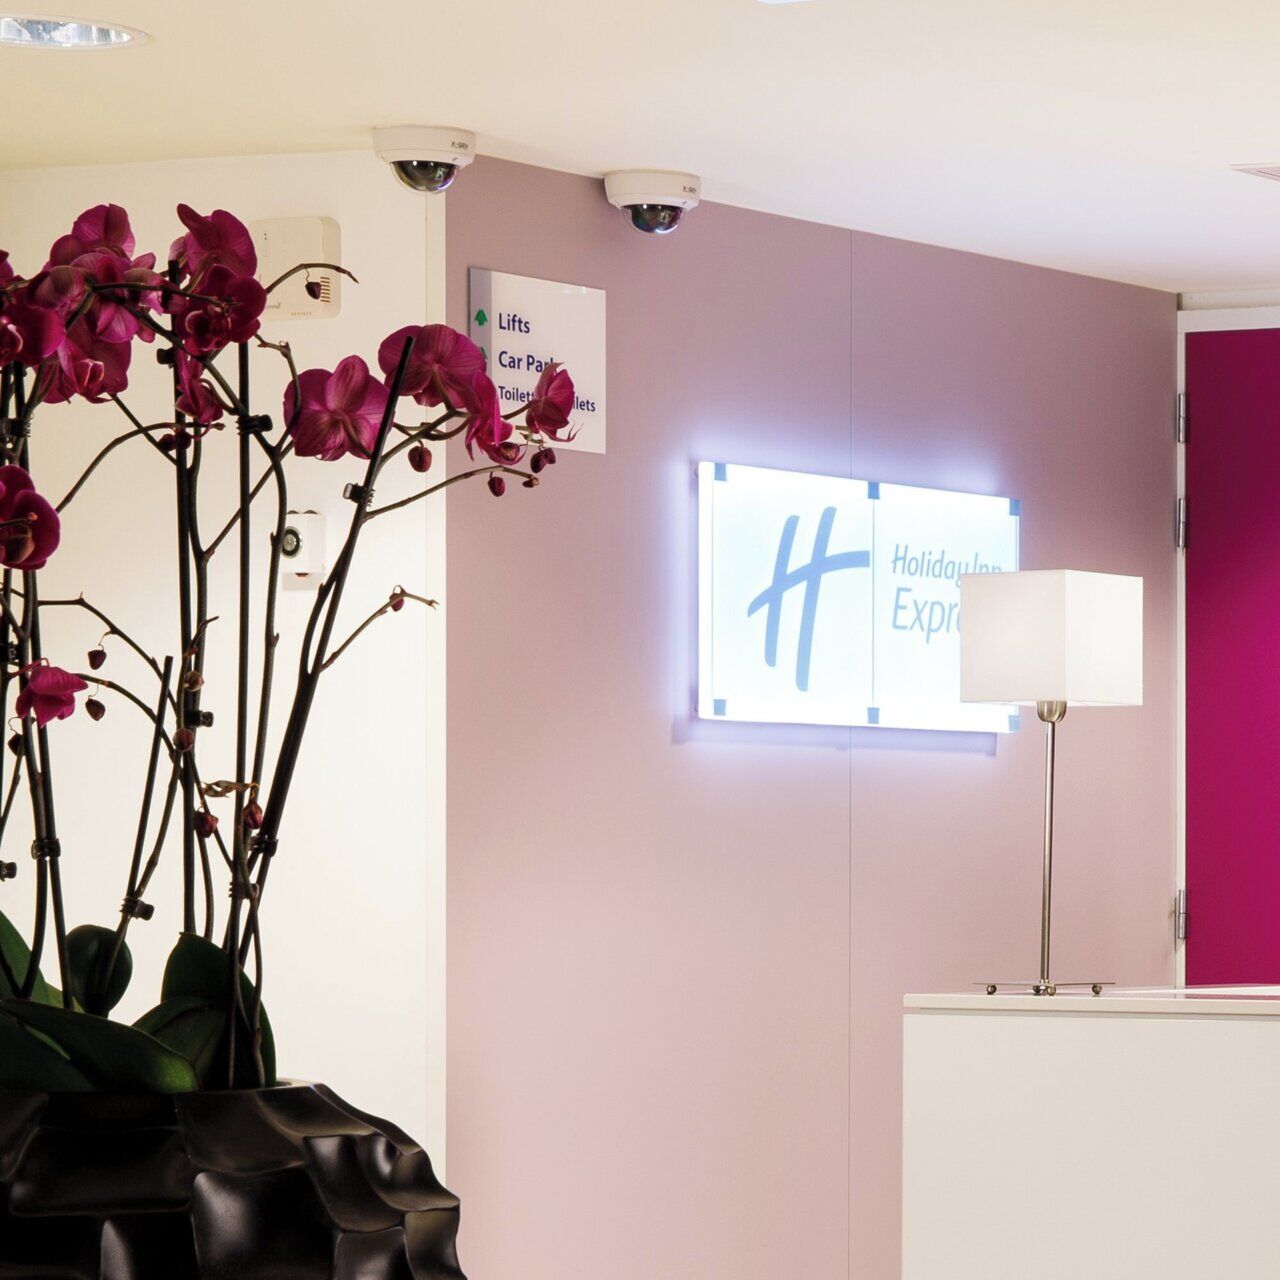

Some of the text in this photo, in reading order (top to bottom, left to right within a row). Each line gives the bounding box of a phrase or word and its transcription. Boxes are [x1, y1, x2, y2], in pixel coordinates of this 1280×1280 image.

[498, 313, 531, 334] Lifts
[498, 350, 554, 373] Car Par
[891, 543, 969, 588] Holiday
[891, 586, 961, 645] Expr
